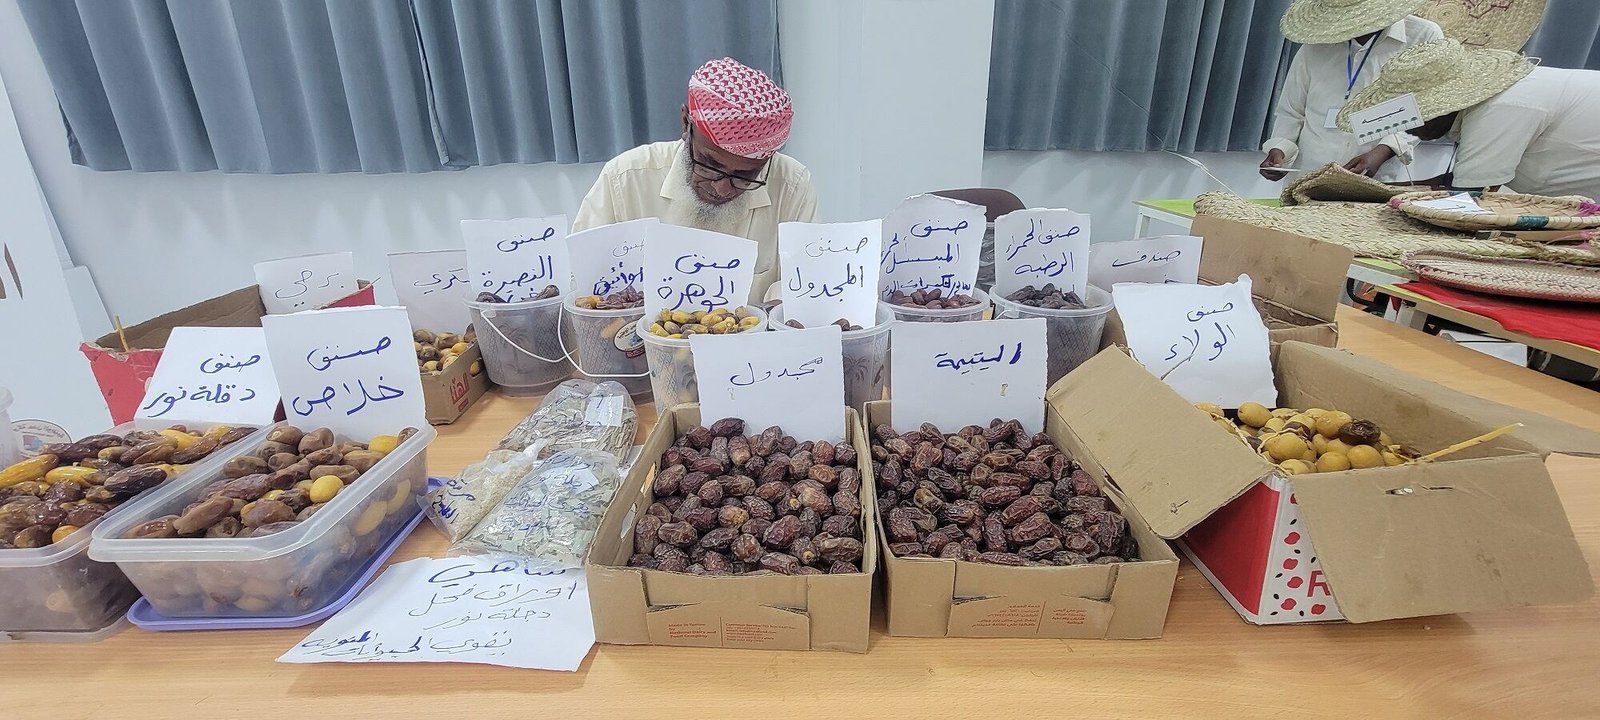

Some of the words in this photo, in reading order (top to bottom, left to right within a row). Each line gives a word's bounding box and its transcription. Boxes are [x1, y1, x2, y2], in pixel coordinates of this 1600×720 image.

[805, 236, 869, 258] صنف
[674, 253, 741, 275] صنف
[413, 268, 471, 295] كري
[788, 262, 865, 303] المجدول
[199, 353, 261, 374] صنف
[306, 336, 392, 372] صنف
[933, 341, 1023, 375] اليتيمة
[729, 356, 824, 386] مجدول
[142, 385, 188, 418] نور
[292, 375, 405, 417] خلاص
